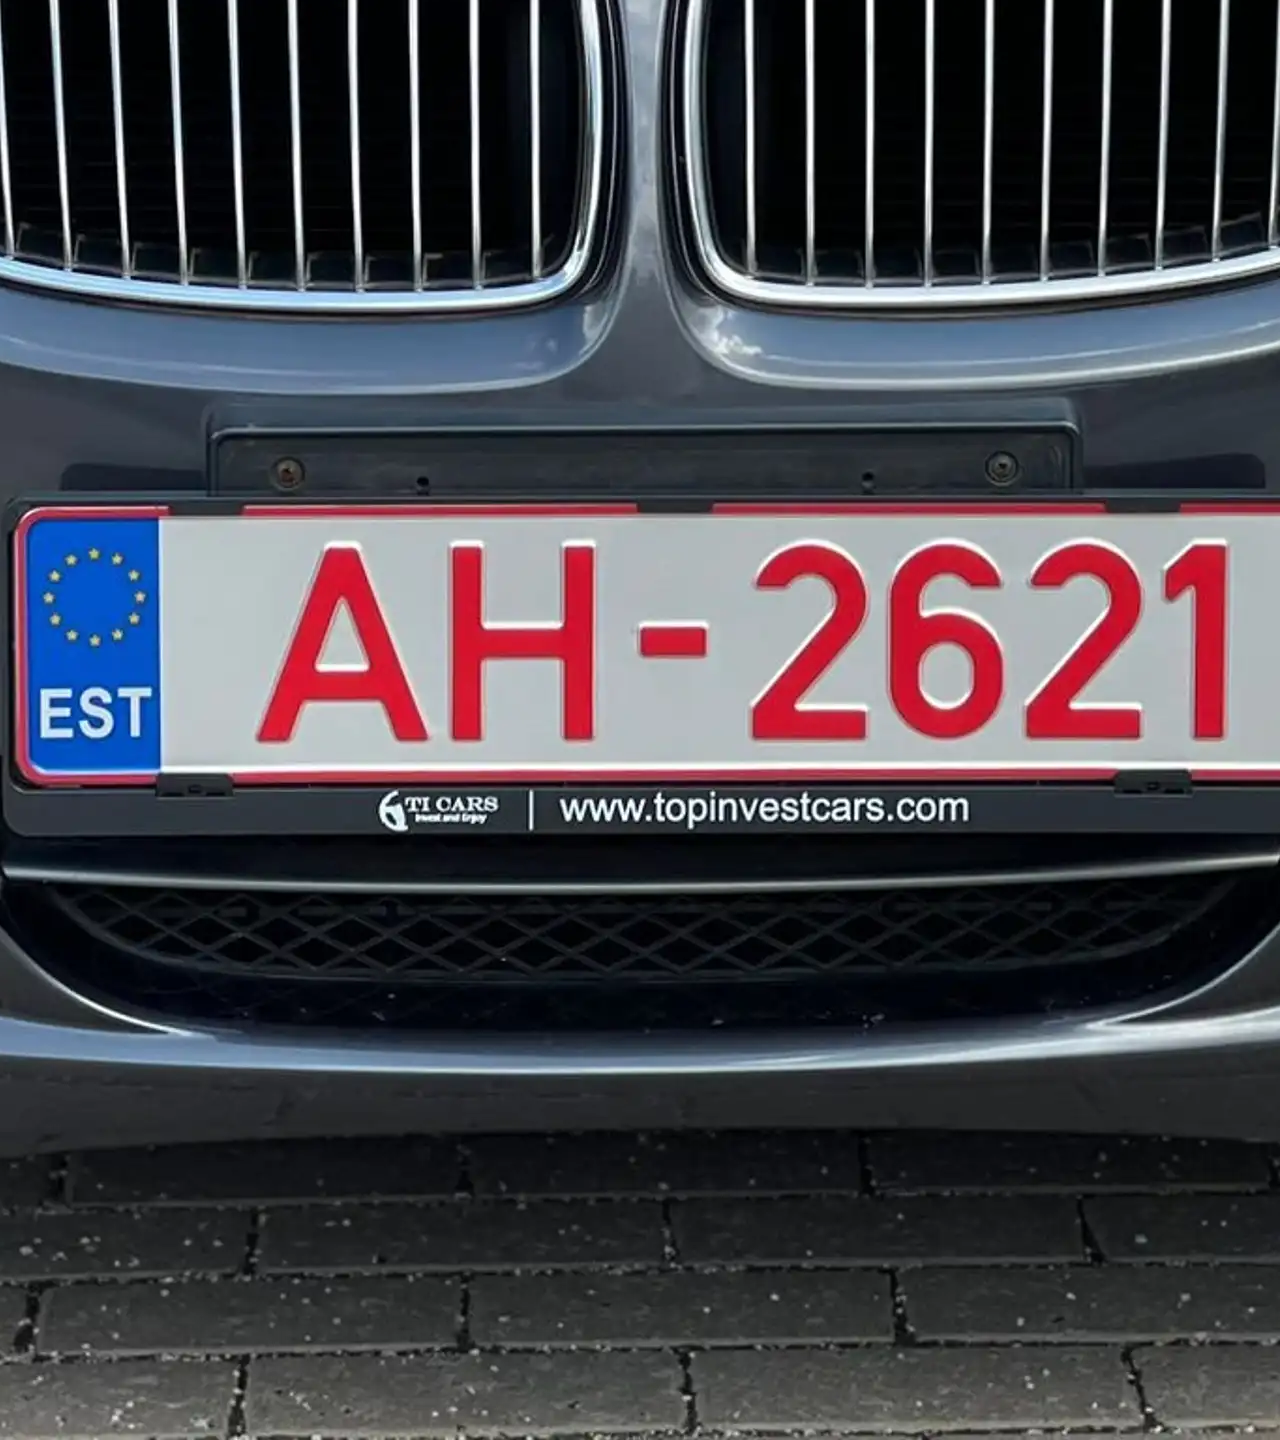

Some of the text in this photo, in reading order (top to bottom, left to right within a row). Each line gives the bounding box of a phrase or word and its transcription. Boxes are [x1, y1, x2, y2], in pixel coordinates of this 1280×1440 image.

[256, 539, 1228, 743] AH-2621
[39, 687, 152, 739] EST
[435, 795, 499, 812] CARS
[559, 790, 970, 830] www.topinvestcars.com
